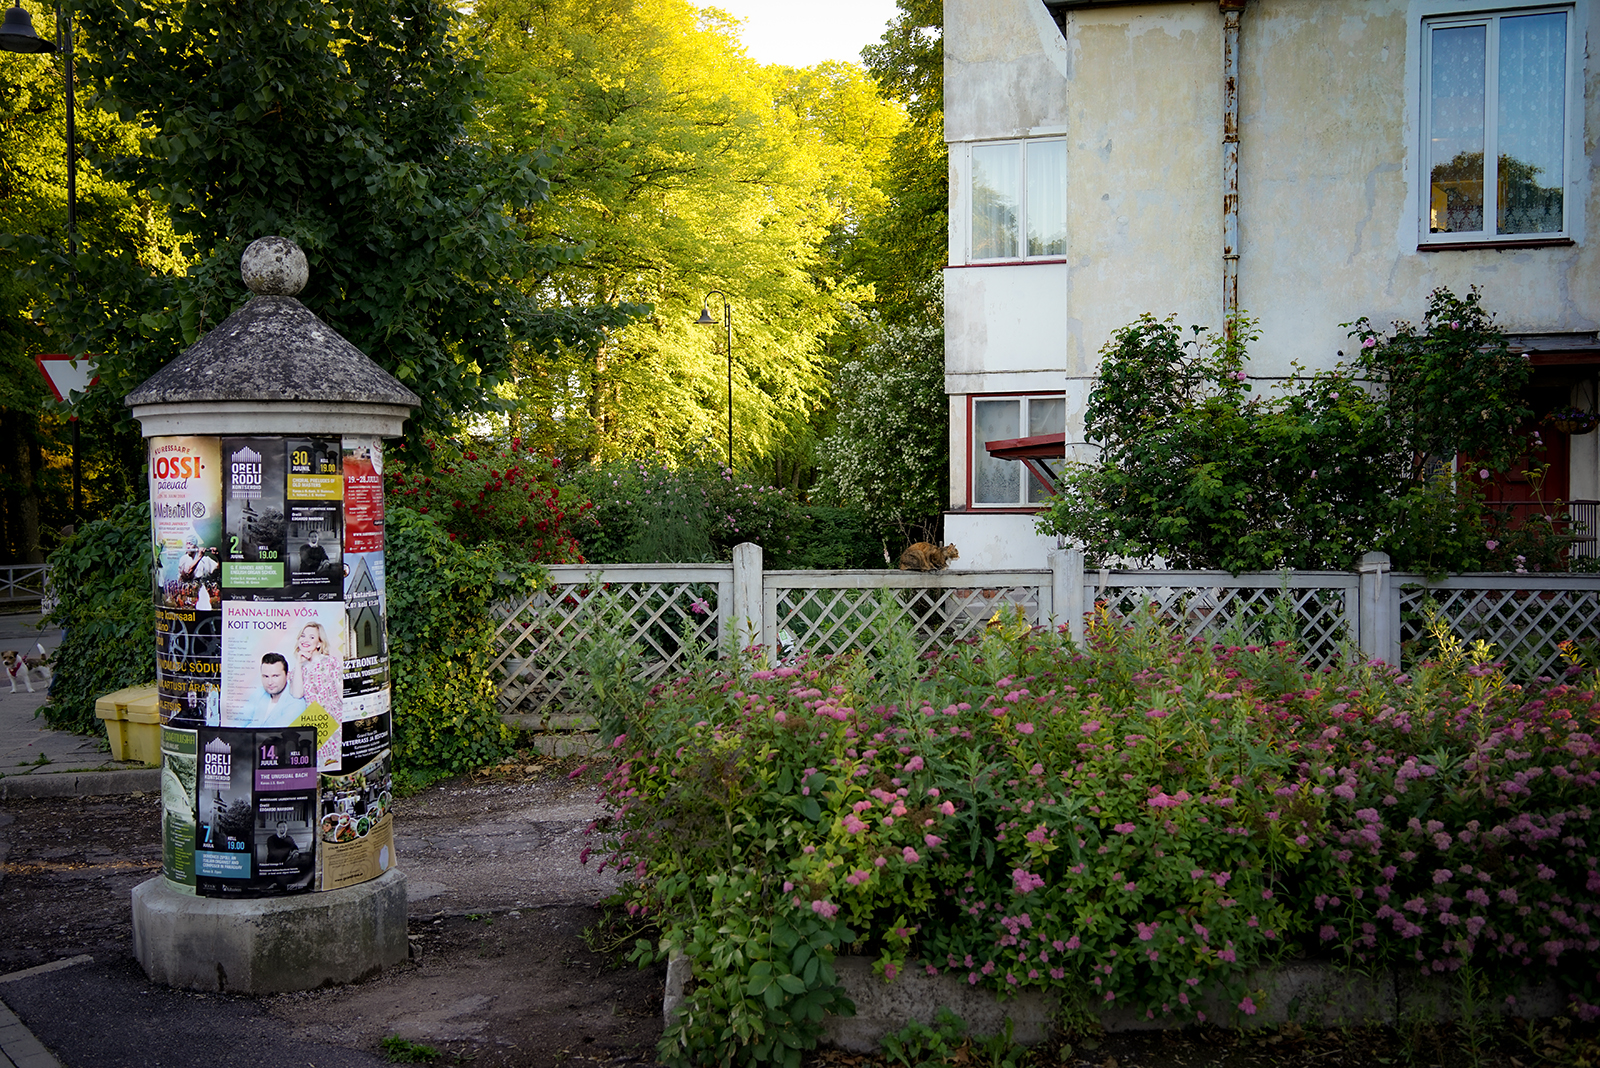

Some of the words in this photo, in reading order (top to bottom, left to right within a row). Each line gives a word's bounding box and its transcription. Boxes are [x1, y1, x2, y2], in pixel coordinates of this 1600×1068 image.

[293, 451, 311, 466] 30.
[153, 457, 201, 479] LOSSI
[232, 463, 261, 474] ORELI
[321, 464, 336, 473] 19.00
[230, 536, 242, 554] 2.
[259, 551, 278, 559] 19.00
[228, 608, 290, 617] HANNA-LIINA
[294, 607, 319, 617] VÕSA
[228, 621, 249, 630] KOIT
[253, 621, 287, 630] TOOME
[260, 745, 279, 760] 14.
[205, 753, 231, 765] ORELI
[290, 756, 309, 765] 19.00
[203, 826, 212, 843] 7.
[227, 842, 245, 850] 19.00
